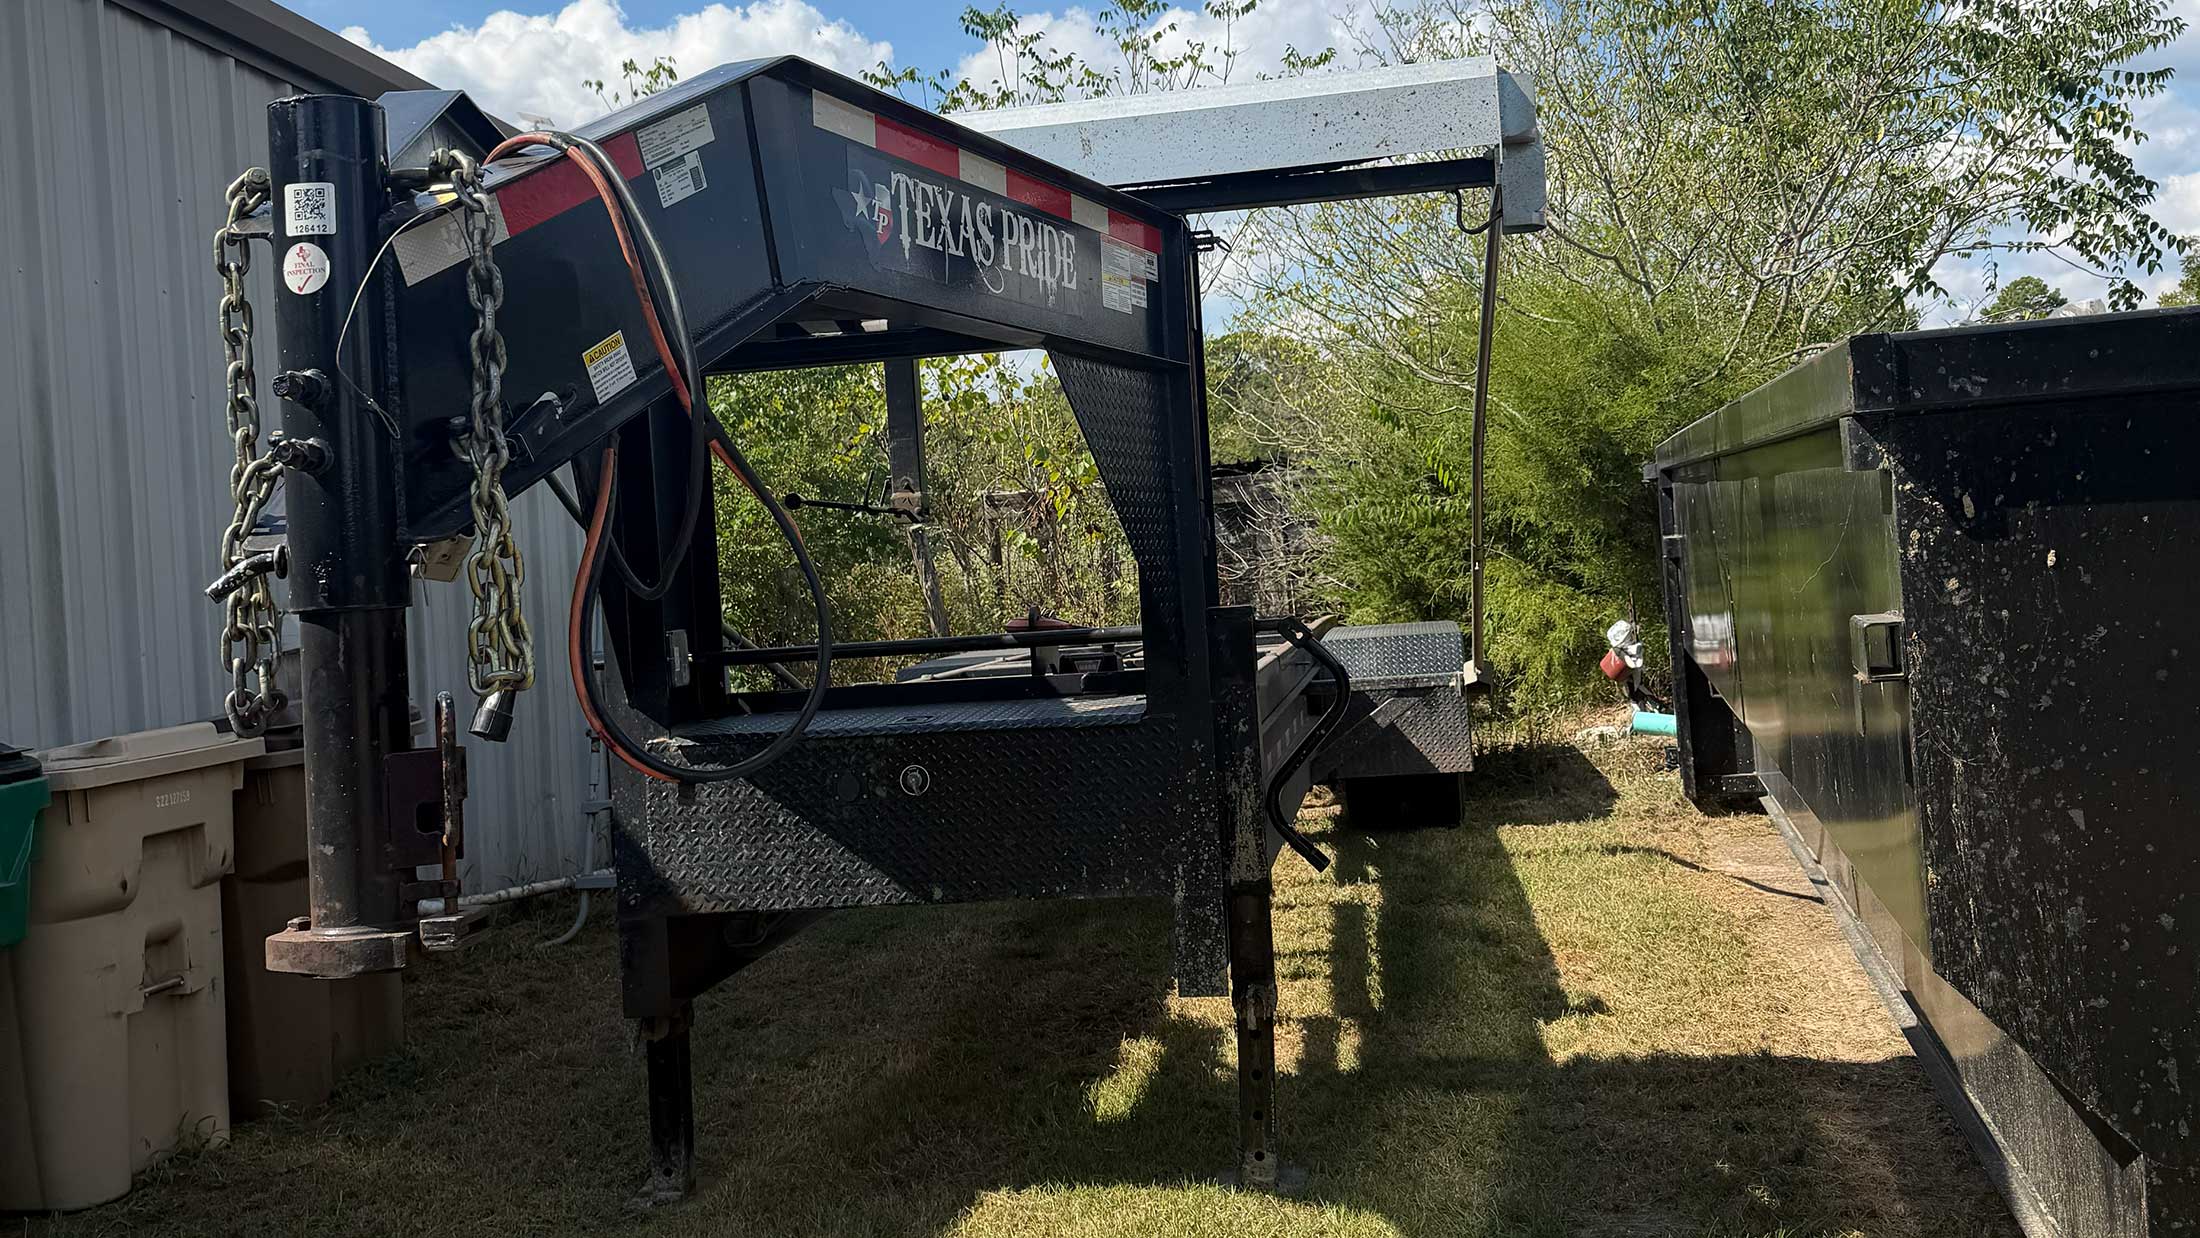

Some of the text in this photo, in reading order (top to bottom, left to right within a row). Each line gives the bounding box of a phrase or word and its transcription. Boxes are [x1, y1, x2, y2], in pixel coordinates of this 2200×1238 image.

[295, 224, 328, 233] 126412
[891, 171, 1077, 300] TEXAS PRIDE
[294, 261, 315, 269] FINAL
[287, 266, 326, 277] INSPECTION
[593, 336, 621, 359] CAUTION
